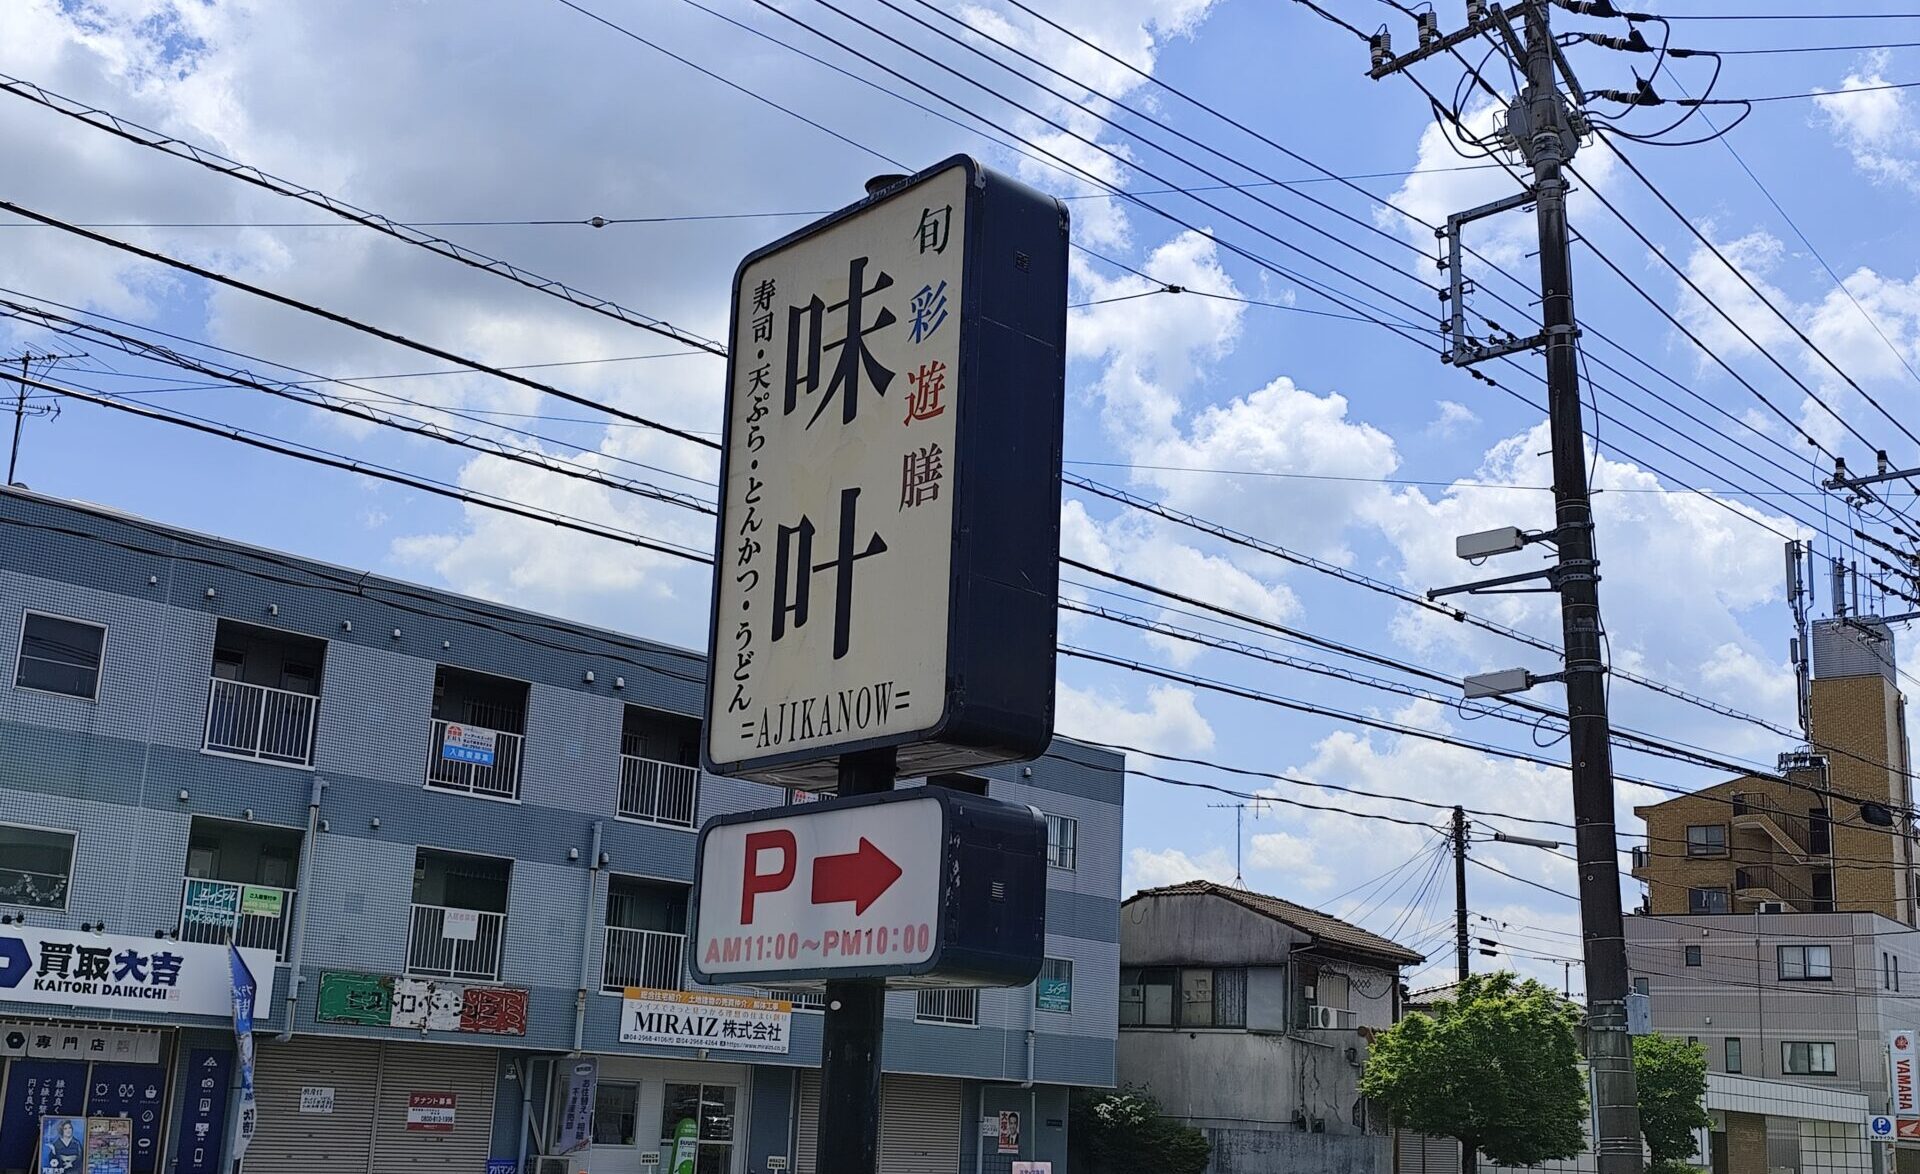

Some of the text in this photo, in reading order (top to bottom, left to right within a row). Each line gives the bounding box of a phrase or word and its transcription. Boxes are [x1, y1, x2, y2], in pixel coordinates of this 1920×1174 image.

[899, 203, 953, 513] 旬彩遊膳
[772, 256, 897, 660] 味叶
[740, 828, 797, 925] P
[36, 940, 185, 987] 買取大吉
[33, 978, 98, 995] KAITORI
[102, 983, 168, 1000] DAIKICHI
[35, 1035, 106, 1052] 専門店
[633, 1011, 782, 1042] MIRAIZ 株式会社
[1896, 1058, 1913, 1111] YAMAHA
[1877, 1118, 1887, 1129] P
